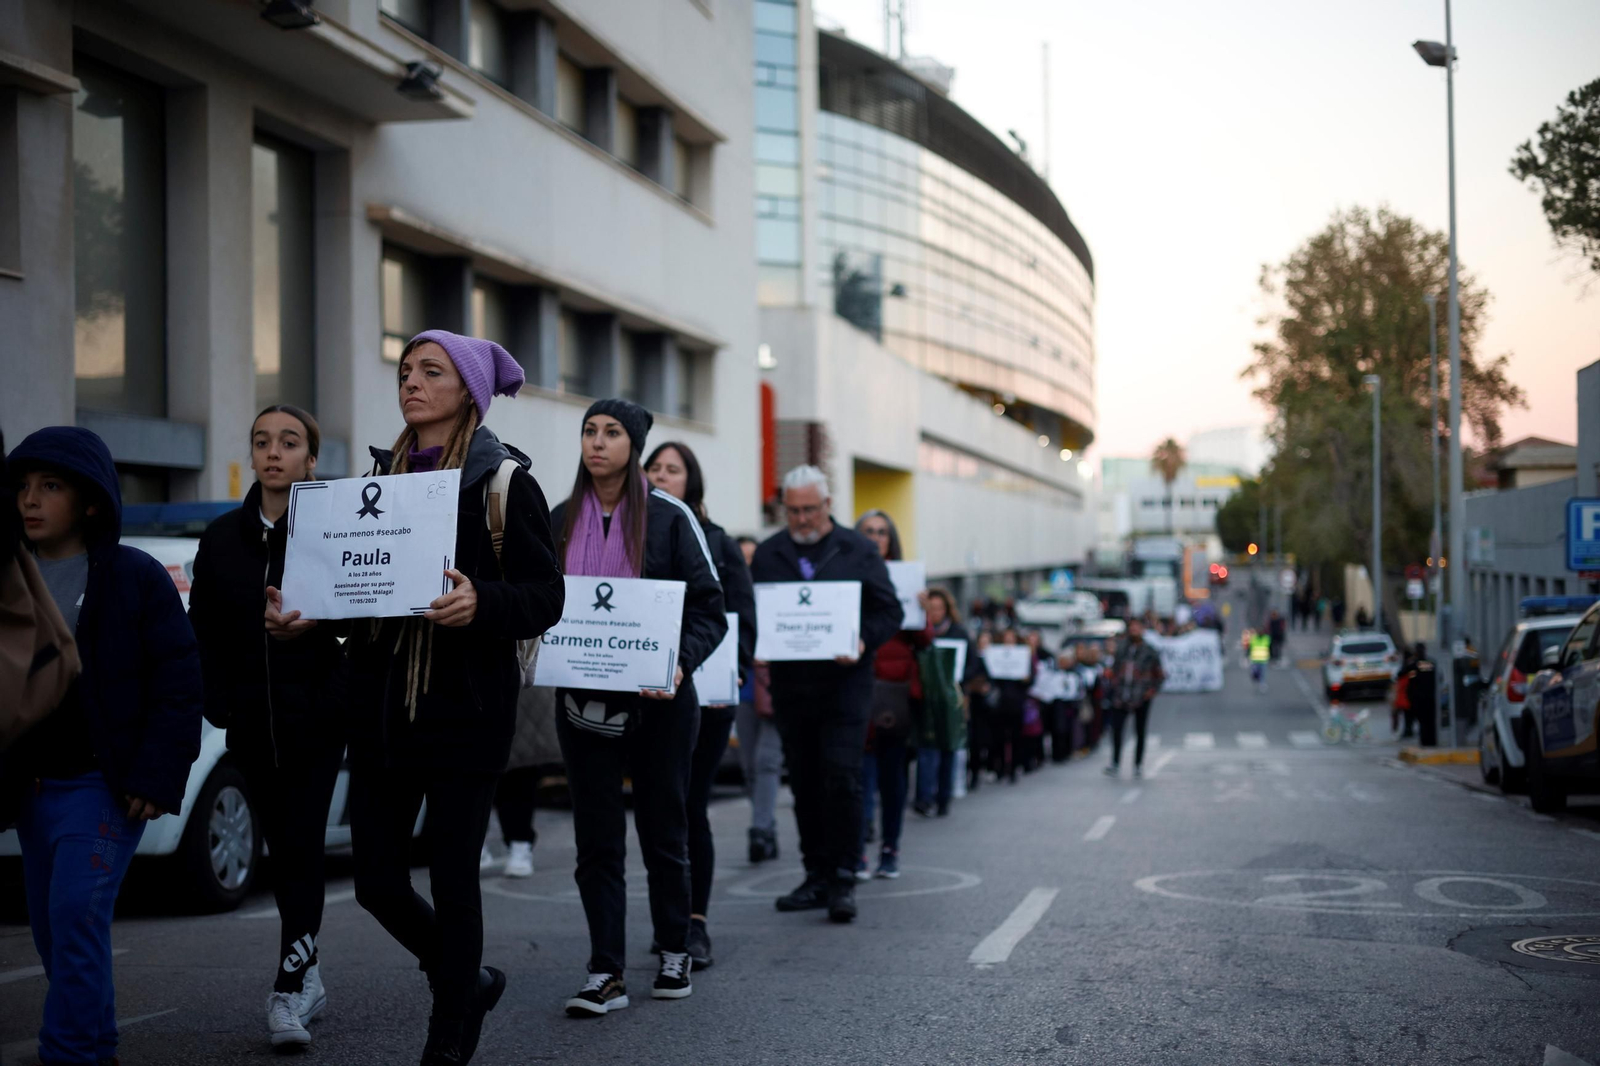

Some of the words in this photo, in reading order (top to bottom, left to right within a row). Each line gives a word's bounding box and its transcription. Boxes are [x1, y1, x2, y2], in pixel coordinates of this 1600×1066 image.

[323, 531, 332, 539] Ni
[333, 531, 348, 539] una
[349, 529, 375, 538] menos
[376, 526, 412, 536] #seacabo
[341, 548, 391, 567] Paula
[334, 581, 360, 589] Asesinada
[378, 580, 395, 588] pareja
[334, 590, 372, 598] (Torremolinos,
[372, 588, 394, 596] Málaga)
[608, 619, 642, 628] #seacabo
[541, 632, 603, 649] Carmen
[608, 635, 659, 652] Cortés
[1255, 873, 1548, 910] 20
